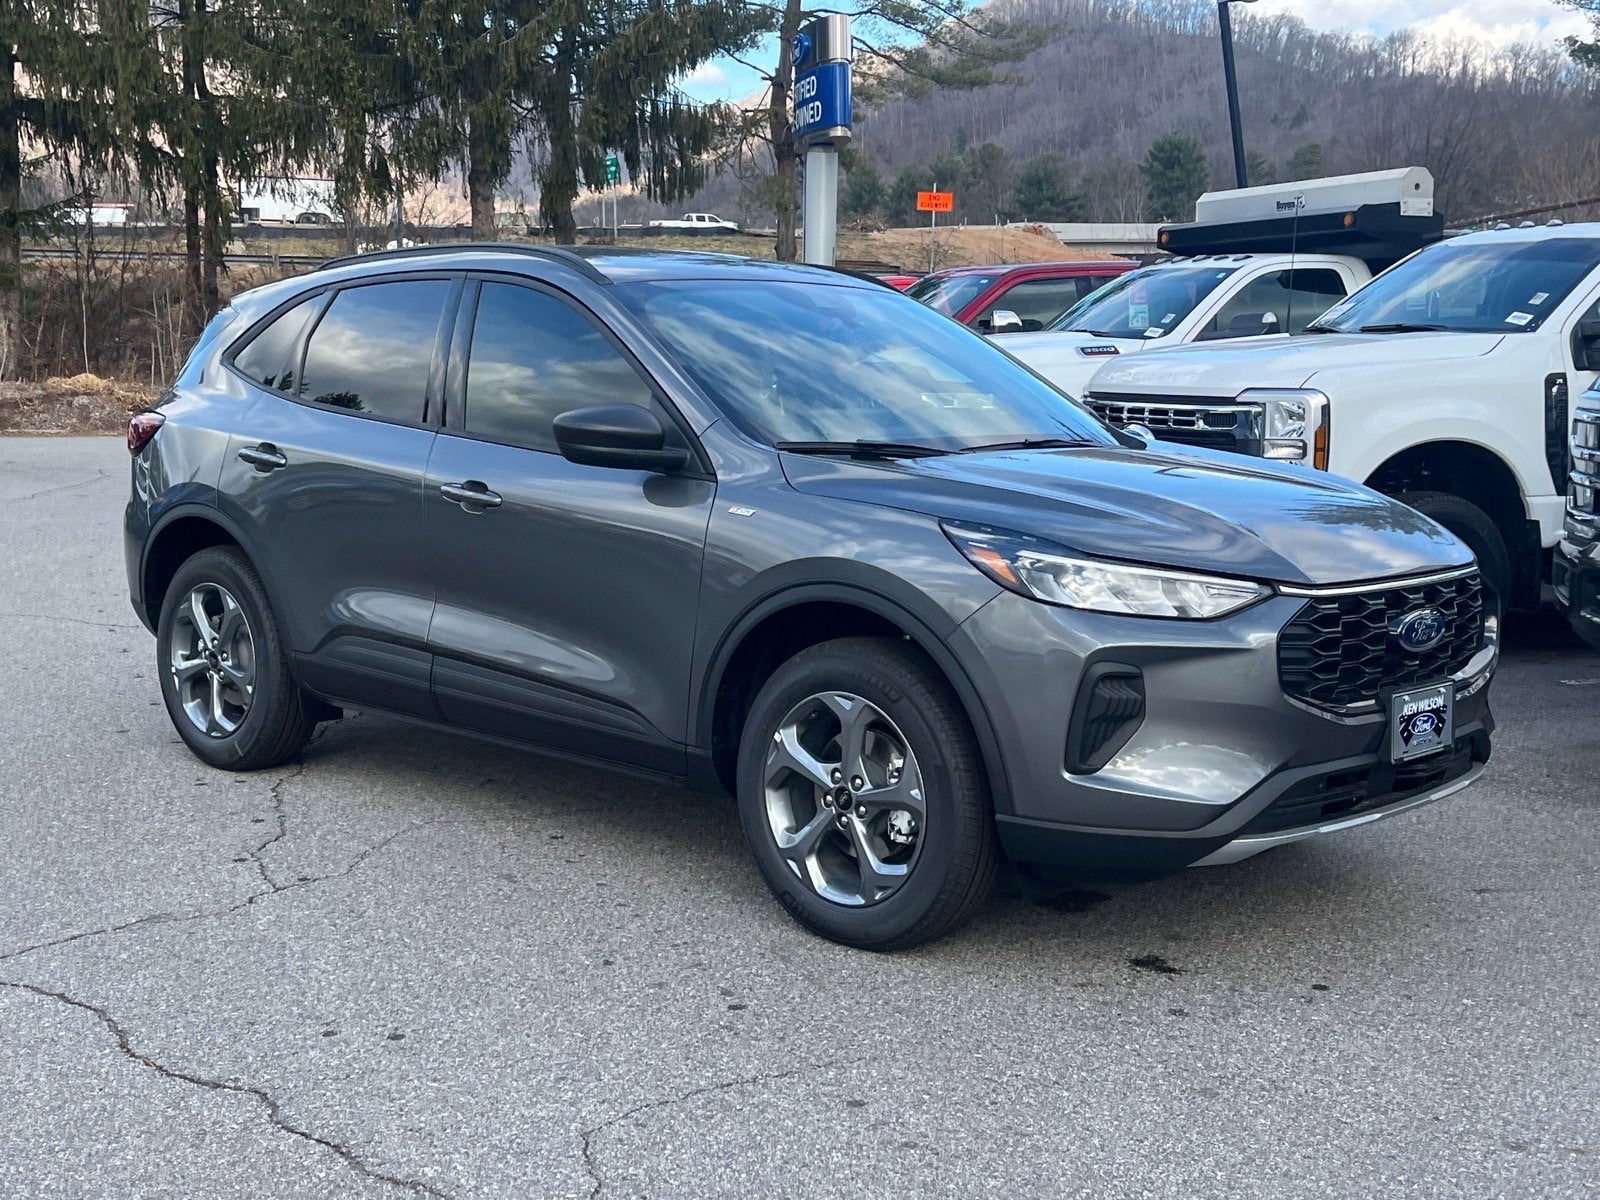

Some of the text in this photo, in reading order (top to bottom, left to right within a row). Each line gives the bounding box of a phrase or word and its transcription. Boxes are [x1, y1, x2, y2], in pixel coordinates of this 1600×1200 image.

[794, 101, 822, 130] OWNED
[1412, 619, 1437, 640] Ford
[1403, 696, 1444, 715] KEN WILSON
[1414, 715, 1433, 734] Ford
